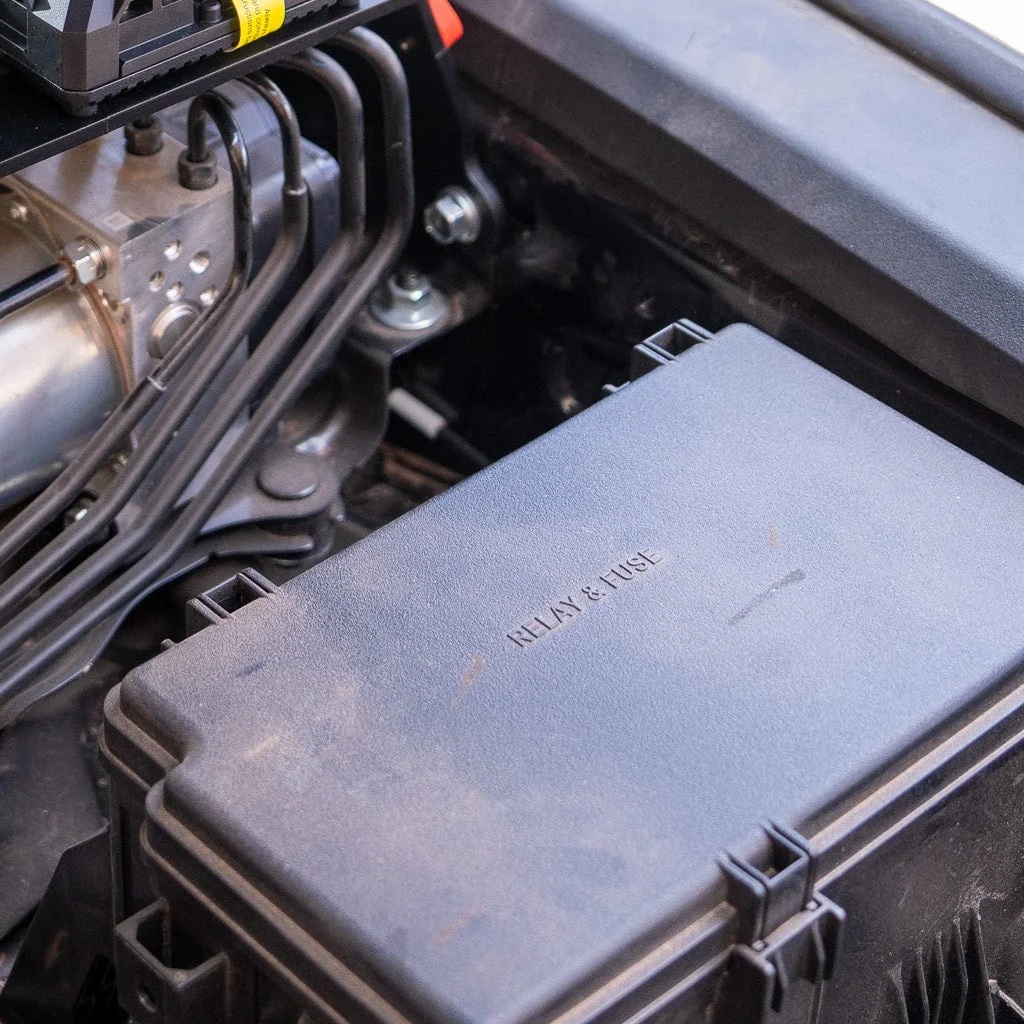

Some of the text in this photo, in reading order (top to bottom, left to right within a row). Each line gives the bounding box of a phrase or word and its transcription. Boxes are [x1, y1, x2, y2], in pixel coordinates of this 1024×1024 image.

[506, 548, 664, 648] RELAY & FUSE
